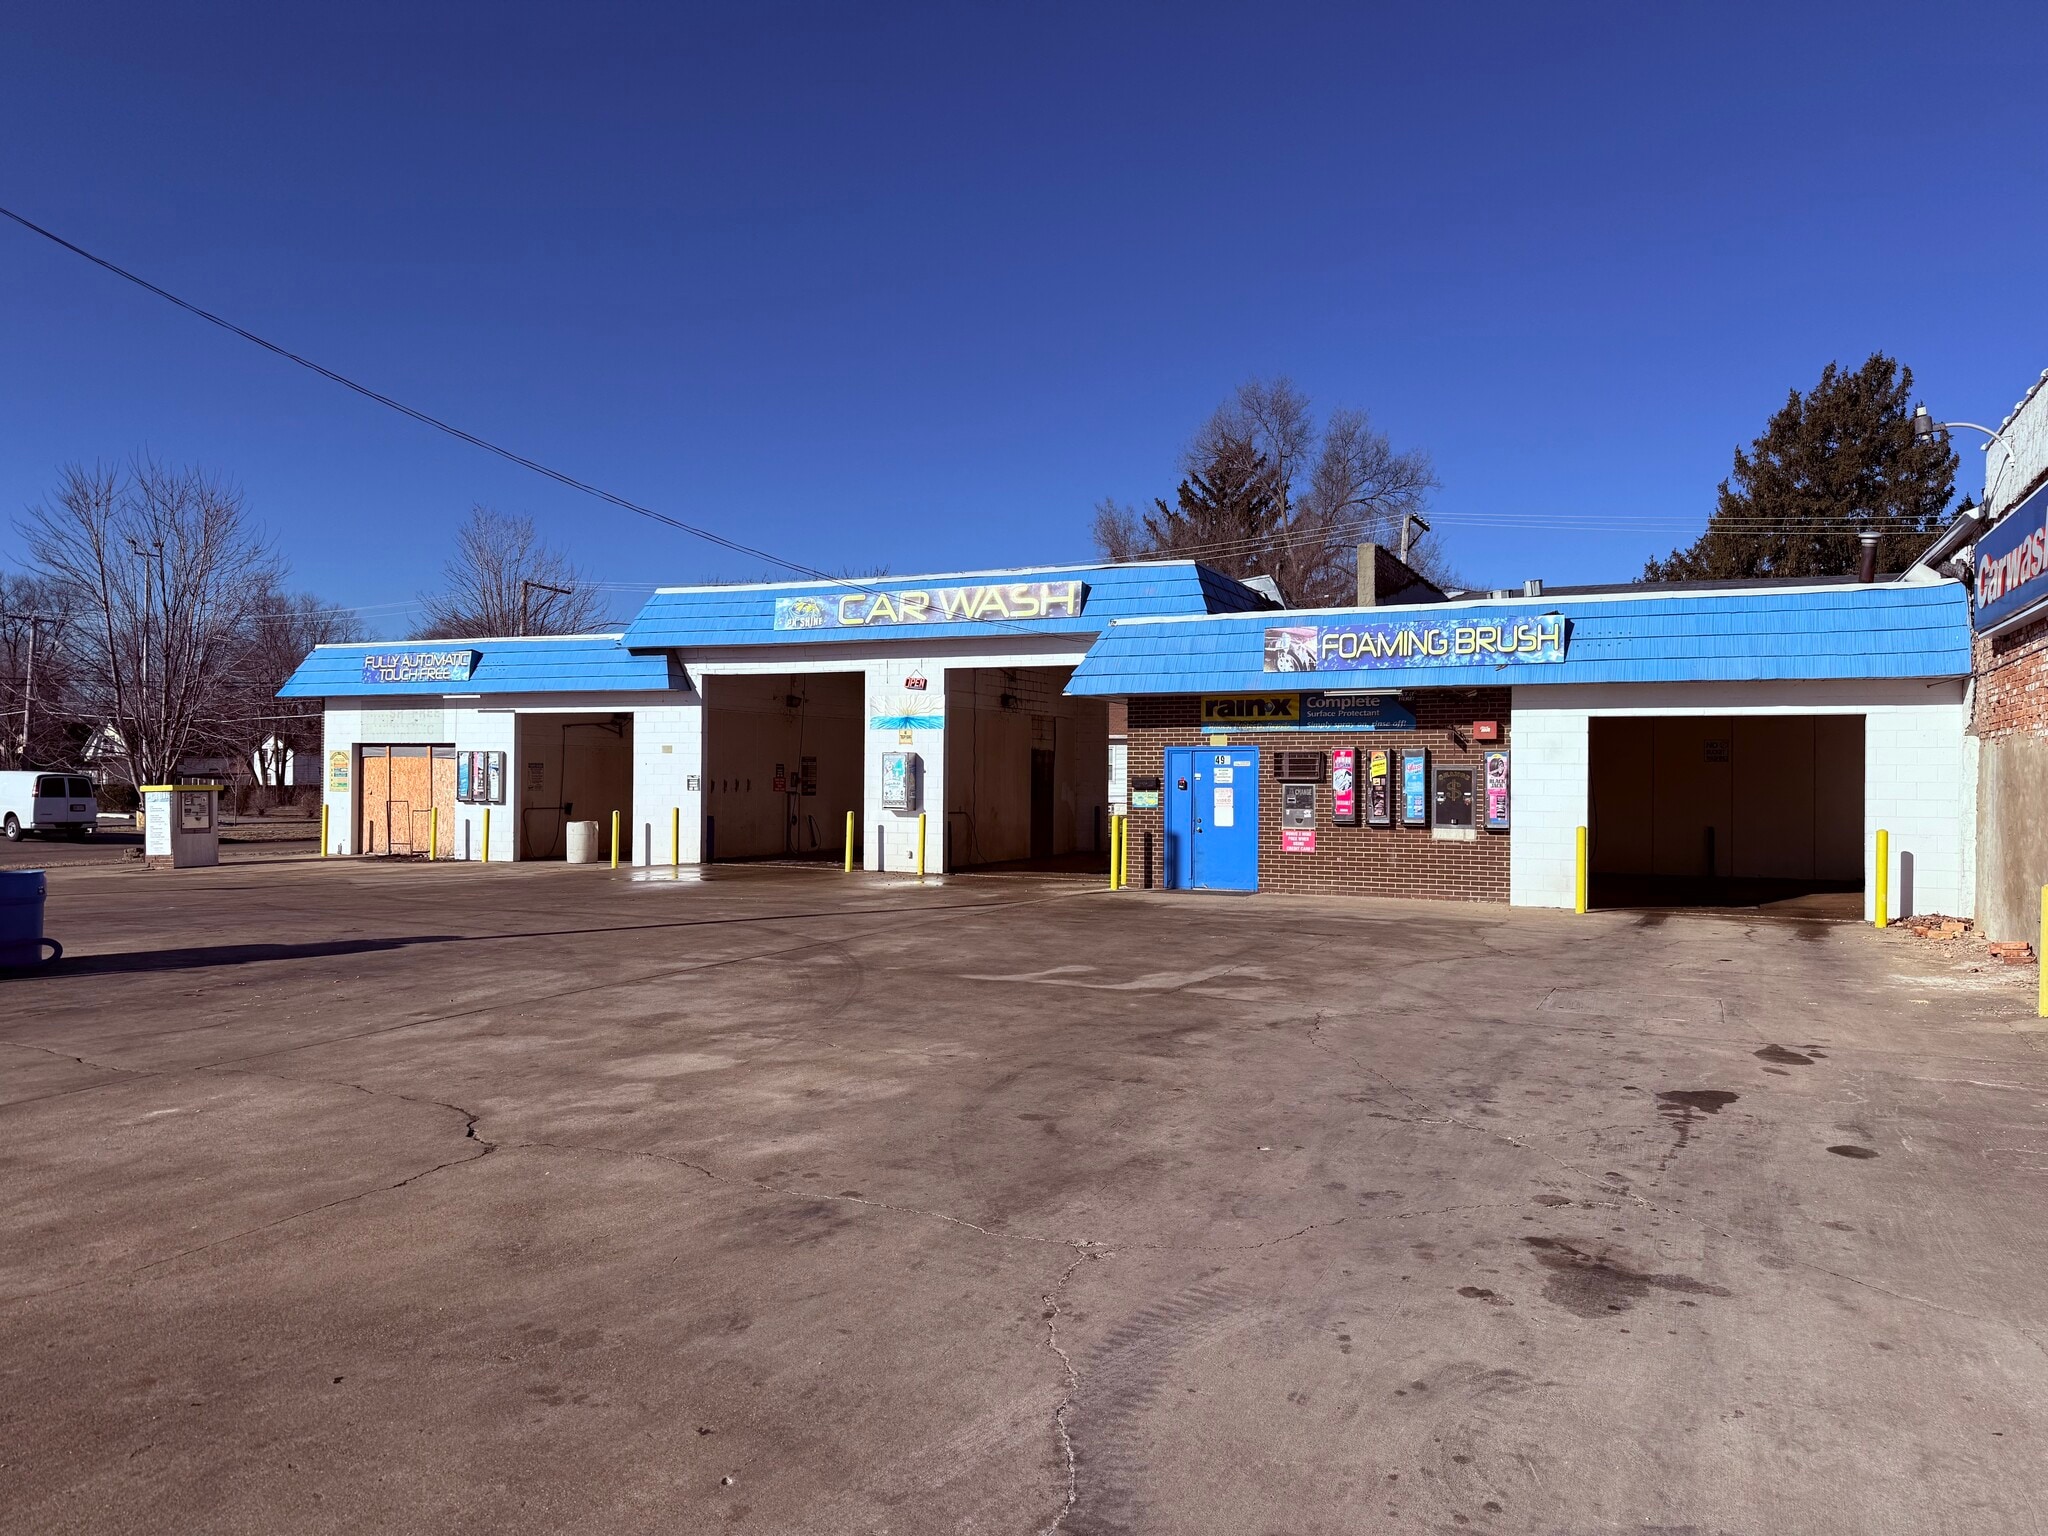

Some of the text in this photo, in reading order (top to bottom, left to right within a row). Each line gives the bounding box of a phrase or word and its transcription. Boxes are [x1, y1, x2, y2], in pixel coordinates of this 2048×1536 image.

[838, 583, 1075, 625] CAR WASH
[1321, 623, 1559, 659] FOAMING BRUSH
[364, 653, 469, 669] FULLY AUTOMATIC
[380, 667, 451, 680] TOUCH FREE
[904, 677, 925, 689] OPEN
[1306, 696, 1380, 710] Complete
[1306, 709, 1380, 718] Surface Protectant
[1306, 721, 1333, 729] Simply
[1334, 721, 1354, 729] spray
[1371, 720, 1391, 728] rinse
[1392, 720, 1408, 729] off!
[1215, 755, 1225, 765] 49
[1294, 788, 1312, 796] CHANGE
